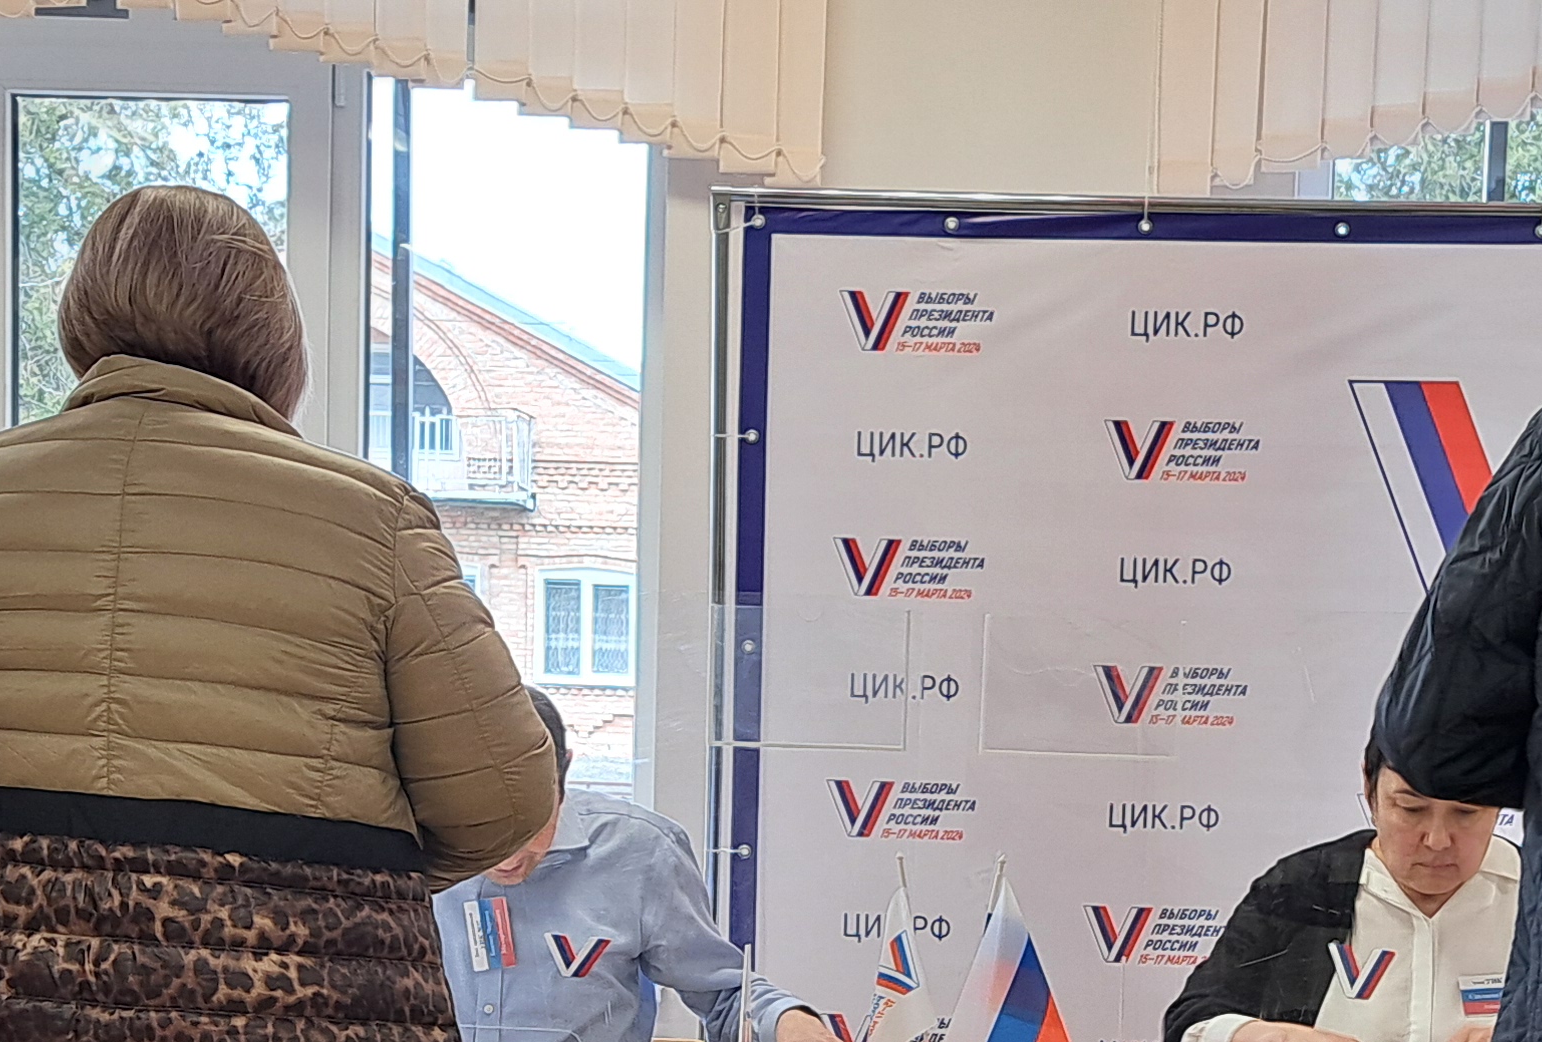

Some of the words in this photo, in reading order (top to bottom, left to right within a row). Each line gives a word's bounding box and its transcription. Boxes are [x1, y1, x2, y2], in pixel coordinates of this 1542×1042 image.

[916, 292, 978, 305] ВЫБОРЫ
[908, 309, 995, 323] ПРЕЗИДЕНТА
[901, 325, 957, 338] РОССИИ
[1130, 310, 1244, 343] ЦИК.РФ
[923, 342, 956, 353] МАРТА
[956, 342, 981, 354] 2024
[1181, 421, 1244, 434] ВЫБОРЫ
[856, 430, 968, 463] ЦИК.РФ
[1173, 438, 1260, 452] ПРЕЗИДЕНТА
[1165, 454, 1223, 467] РОССИИ
[1188, 470, 1221, 482] МАРТА
[1222, 471, 1246, 483] 2024
[908, 539, 969, 553] ВЫБОРЫ
[900, 556, 985, 570] ПРЕЗИДЕНТА
[893, 572, 949, 585] РОССИИ
[1119, 557, 1232, 588] ЦИК.РФ
[914, 588, 948, 599] МАРТА
[948, 589, 972, 600] 2024
[1210, 715, 1234, 727] 2024
[900, 782, 961, 795] ВЫБОРЫ
[893, 798, 976, 812] ПРЕЗИДЕНТА
[886, 813, 941, 826] РОССИИ
[1108, 803, 1220, 833] ЦИК.РФ
[907, 829, 939, 840] МАРТА
[940, 829, 964, 841] 2024
[1158, 908, 1219, 921] ВЫБОРЫ
[843, 912, 951, 943] ЦИРФ
[1150, 924, 1226, 938] ПРЕЗИДЕН
[1143, 940, 1199, 952] РОССИИ
[1165, 955, 1199, 966] МАРТА
